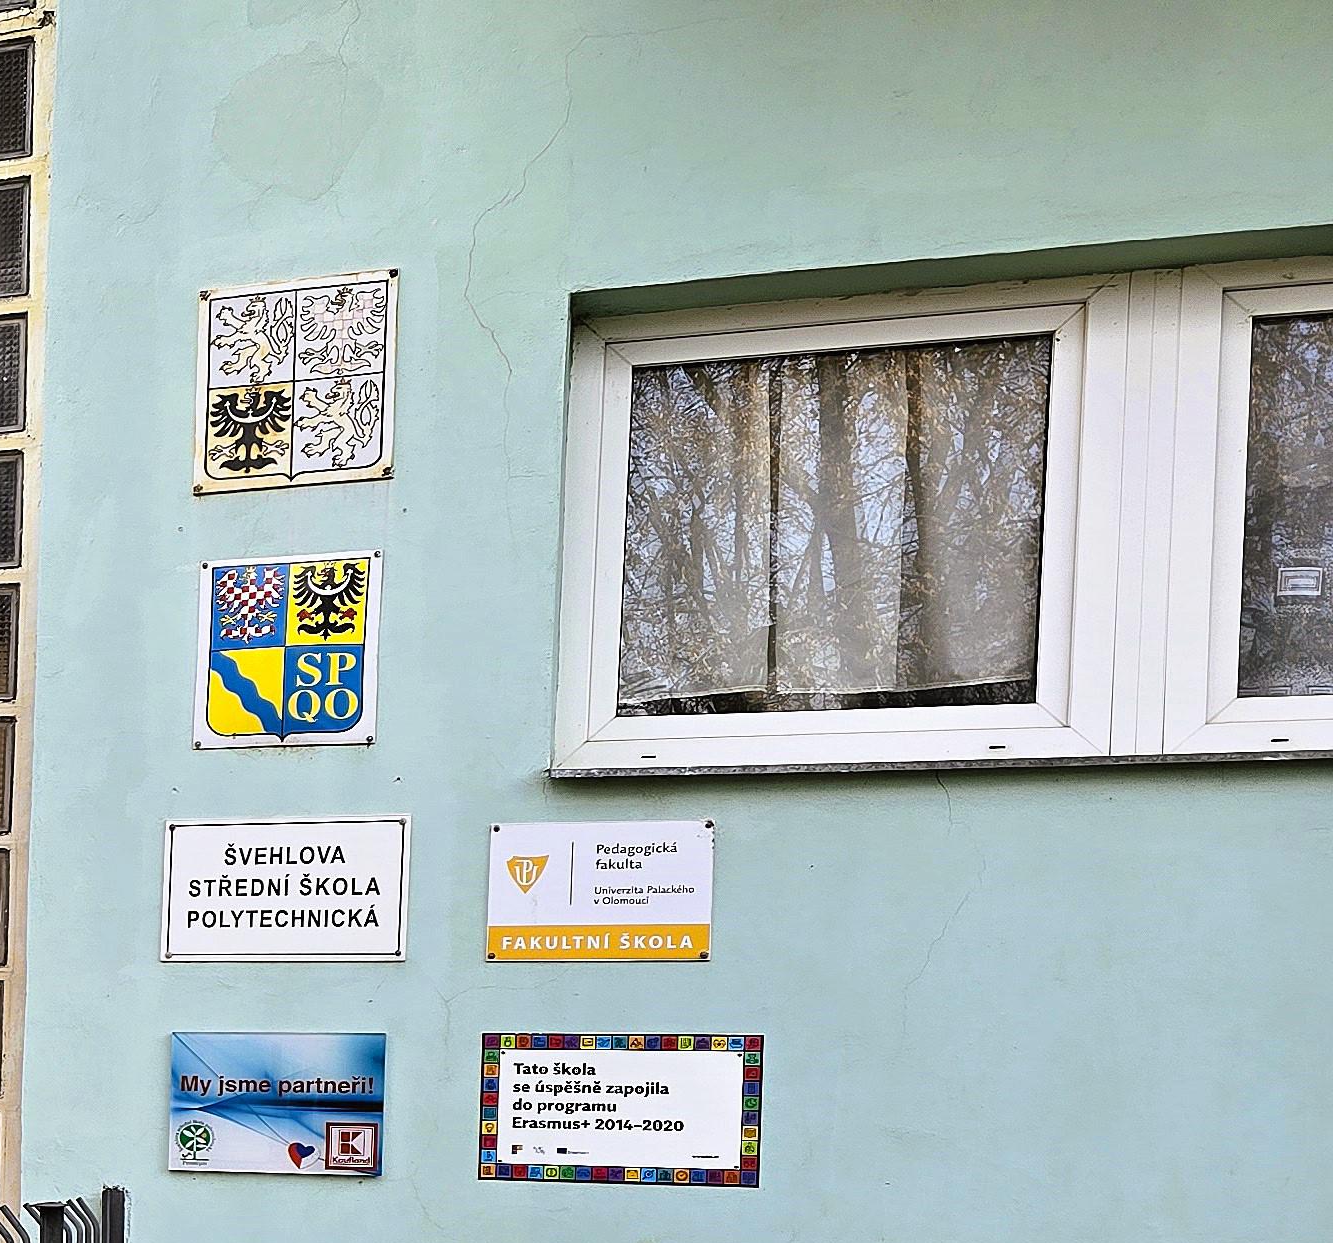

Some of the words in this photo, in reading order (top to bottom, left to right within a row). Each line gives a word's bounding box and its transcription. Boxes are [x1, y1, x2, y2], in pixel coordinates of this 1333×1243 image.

[296, 652, 357, 687] SP
[287, 688, 359, 723] QO
[224, 843, 346, 866] ŠVEHLOVA
[596, 841, 678, 857] Pedagogická
[595, 858, 643, 871] fakulta
[188, 874, 290, 897] STŘEDNÍ
[299, 873, 381, 896] ŠKOLA
[594, 886, 644, 895] Univerzita
[647, 884, 695, 895] Palackého
[602, 896, 649, 905] Olomouci
[187, 904, 380, 929] POLYTECHNICKÁ
[501, 932, 611, 950] FAKULTNÍ
[619, 932, 693, 949] ŠKOLA
[513, 1062, 549, 1075] Tato
[553, 1062, 596, 1076] škola
[181, 1075, 212, 1096] My
[217, 1075, 272, 1096] jsme
[278, 1076, 374, 1097] partneři!
[513, 1082, 531, 1093] se
[535, 1080, 602, 1097] úspěšně
[605, 1081, 670, 1097] zapojila
[512, 1098, 533, 1111] do
[537, 1101, 617, 1114] programu
[512, 1117, 591, 1130] Erasmus+
